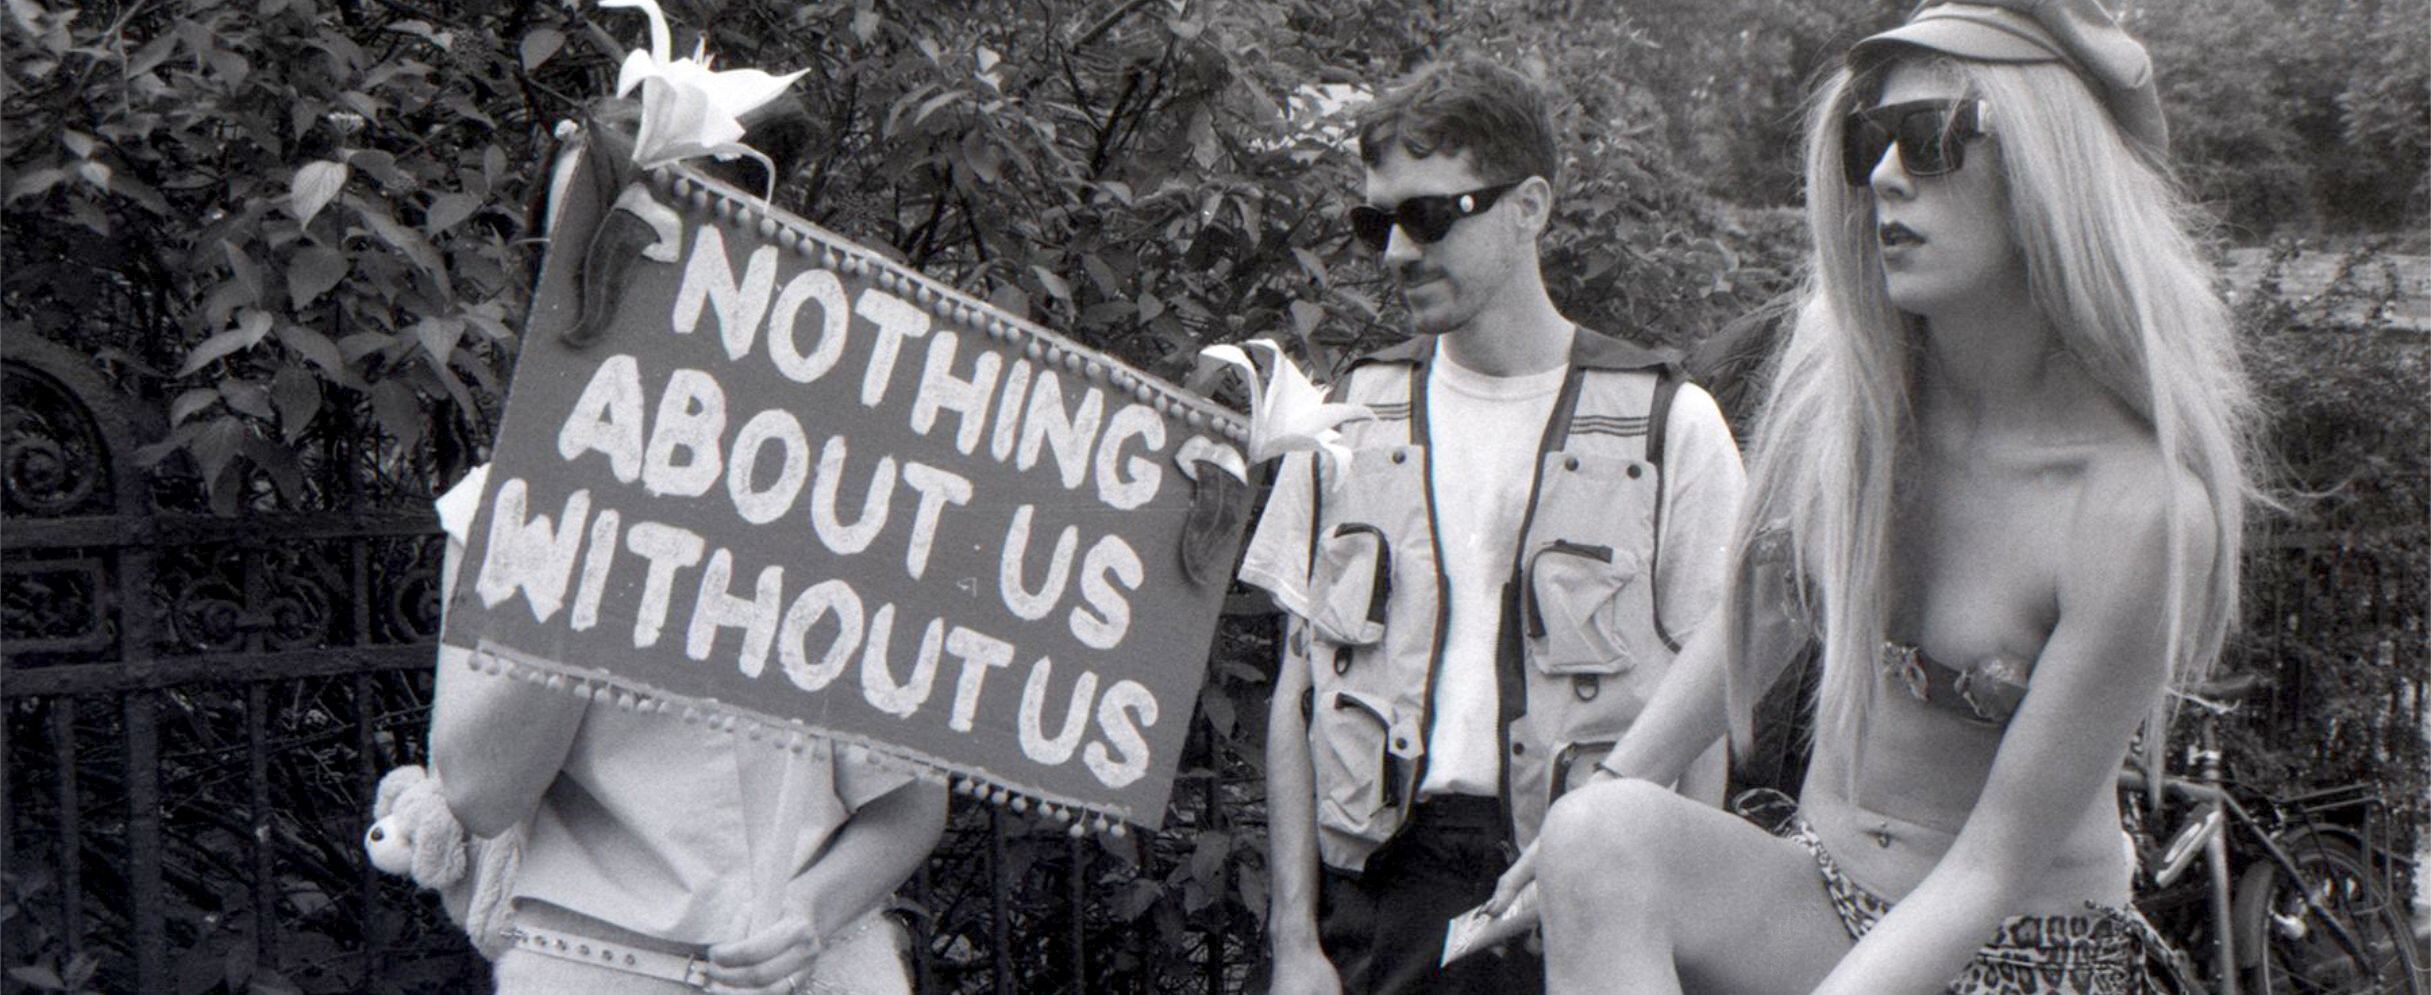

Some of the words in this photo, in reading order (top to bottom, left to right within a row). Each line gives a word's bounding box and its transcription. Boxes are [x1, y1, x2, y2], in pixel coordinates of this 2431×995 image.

[558, 354, 973, 580] ABOUT
[999, 504, 1144, 650] US
[672, 225, 1167, 511] NOTHING
[476, 478, 1015, 732] WITHOUT
[1018, 656, 1159, 788] US
